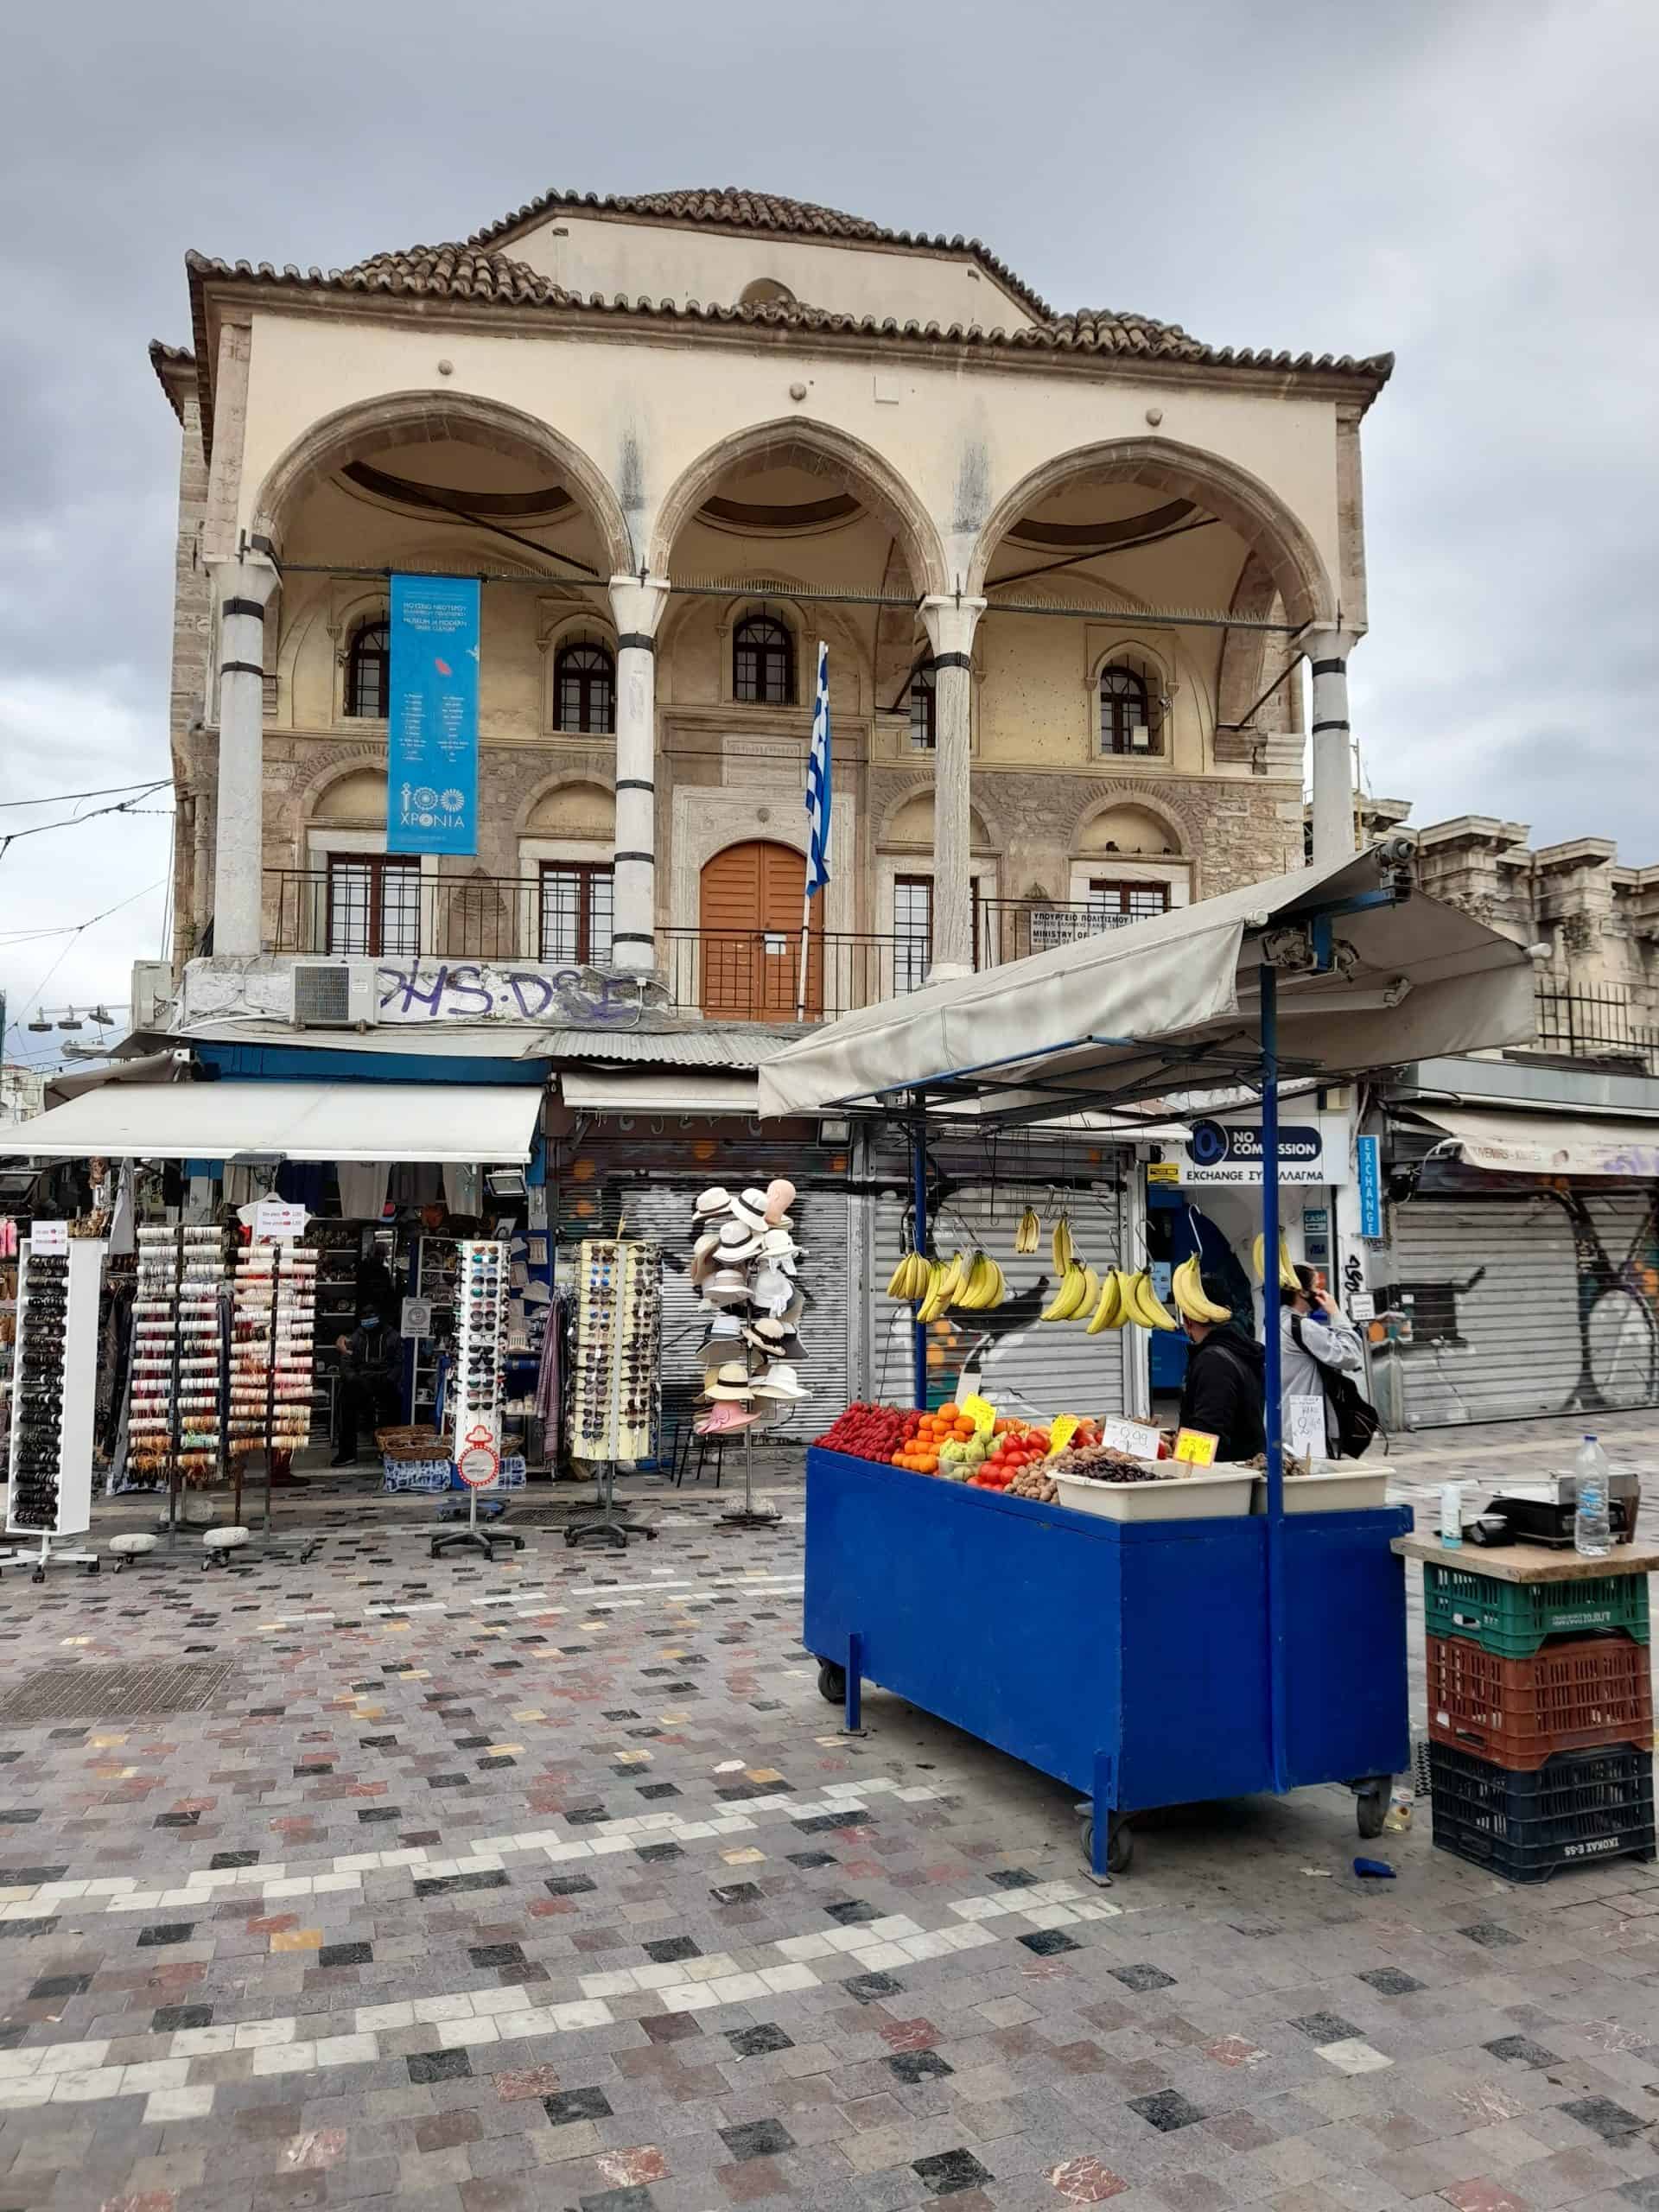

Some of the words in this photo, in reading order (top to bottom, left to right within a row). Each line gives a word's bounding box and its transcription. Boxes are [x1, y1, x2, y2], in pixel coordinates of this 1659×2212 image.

[400, 812, 465, 829] ΧΡΟΝΙΑ
[1033, 930, 1072, 938] MINISTRY
[1233, 1131, 1254, 1142] NO
[1233, 1143, 1316, 1155] COMSSION
[1186, 1171, 1243, 1181] EXCHANGE
[1249, 1171, 1324, 1181] ΣΥΛΛΑΓΜΑ
[1364, 1140, 1375, 1235] EXCHANGE
